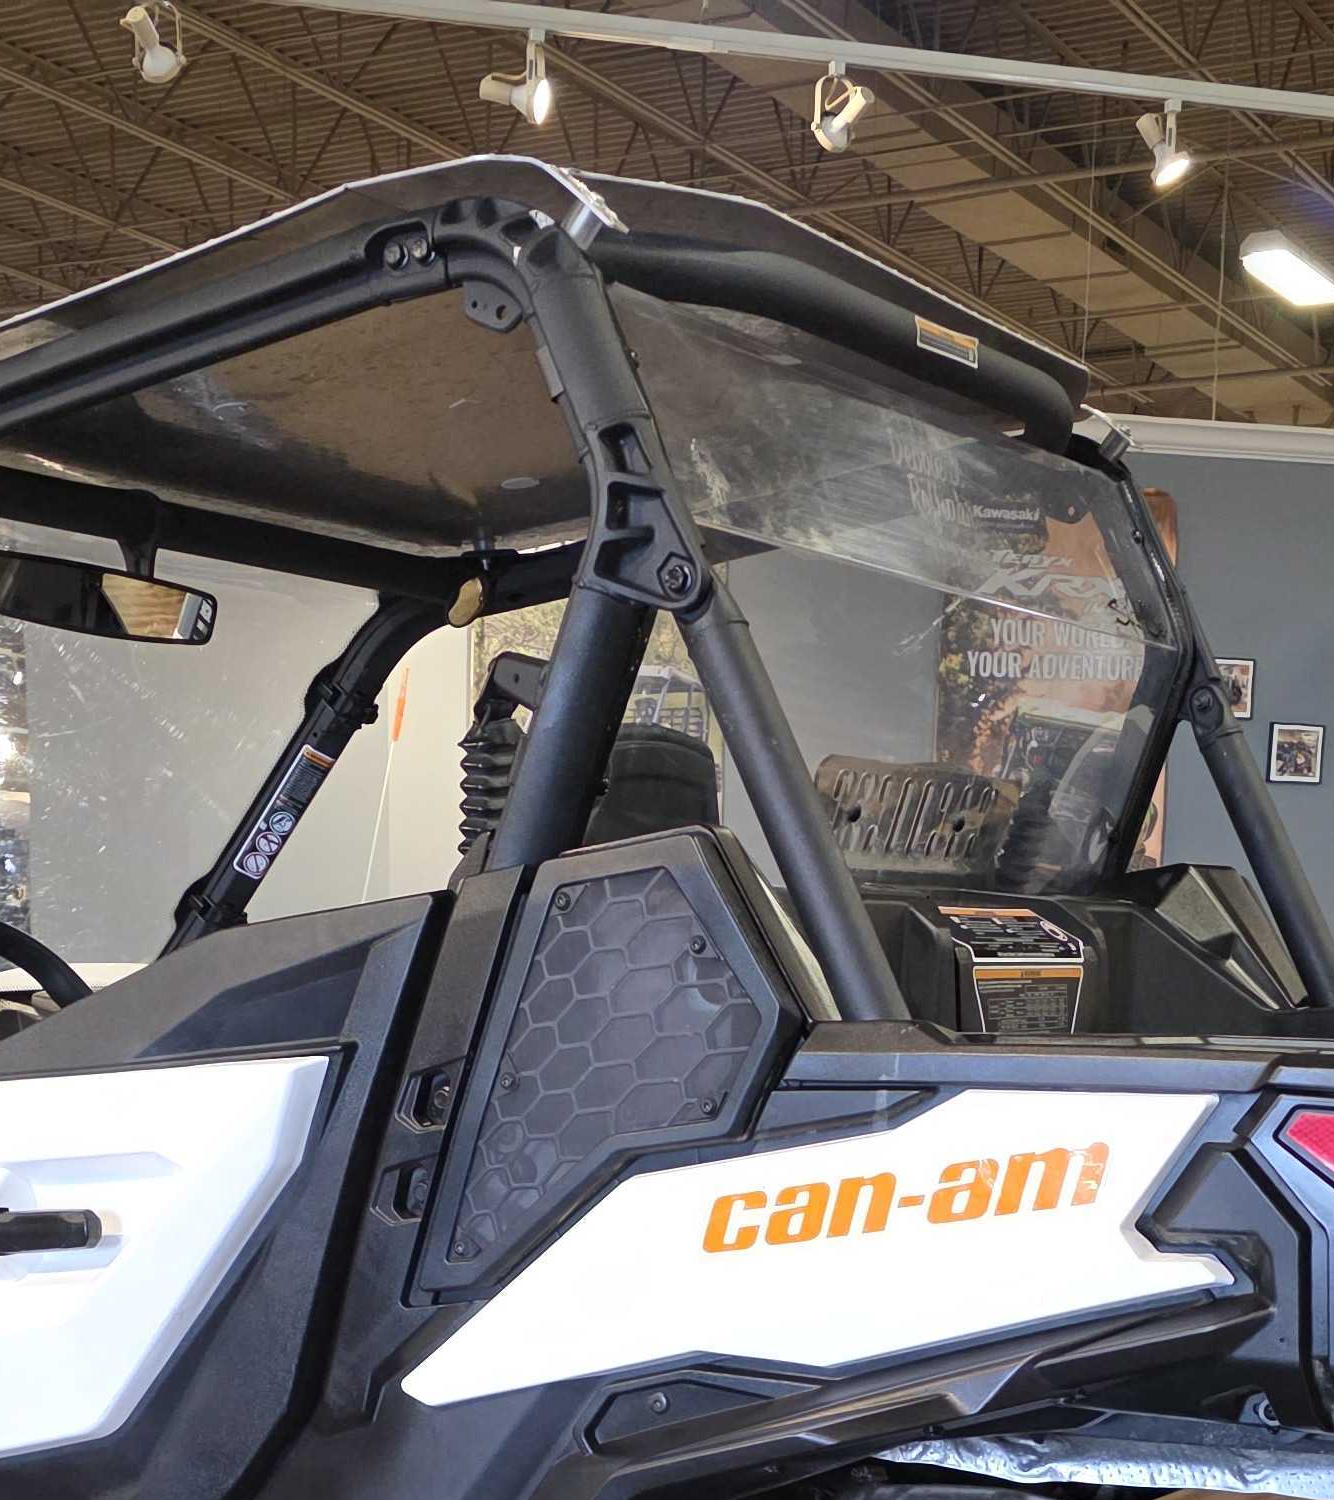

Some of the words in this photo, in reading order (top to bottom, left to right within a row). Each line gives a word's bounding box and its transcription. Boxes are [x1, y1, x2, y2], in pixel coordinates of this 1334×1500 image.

[972, 504, 1041, 522] Kawasaki
[990, 617, 1046, 647] YOUR
[967, 650, 1021, 678] YOUR
[702, 1142, 1109, 1253] can-am
